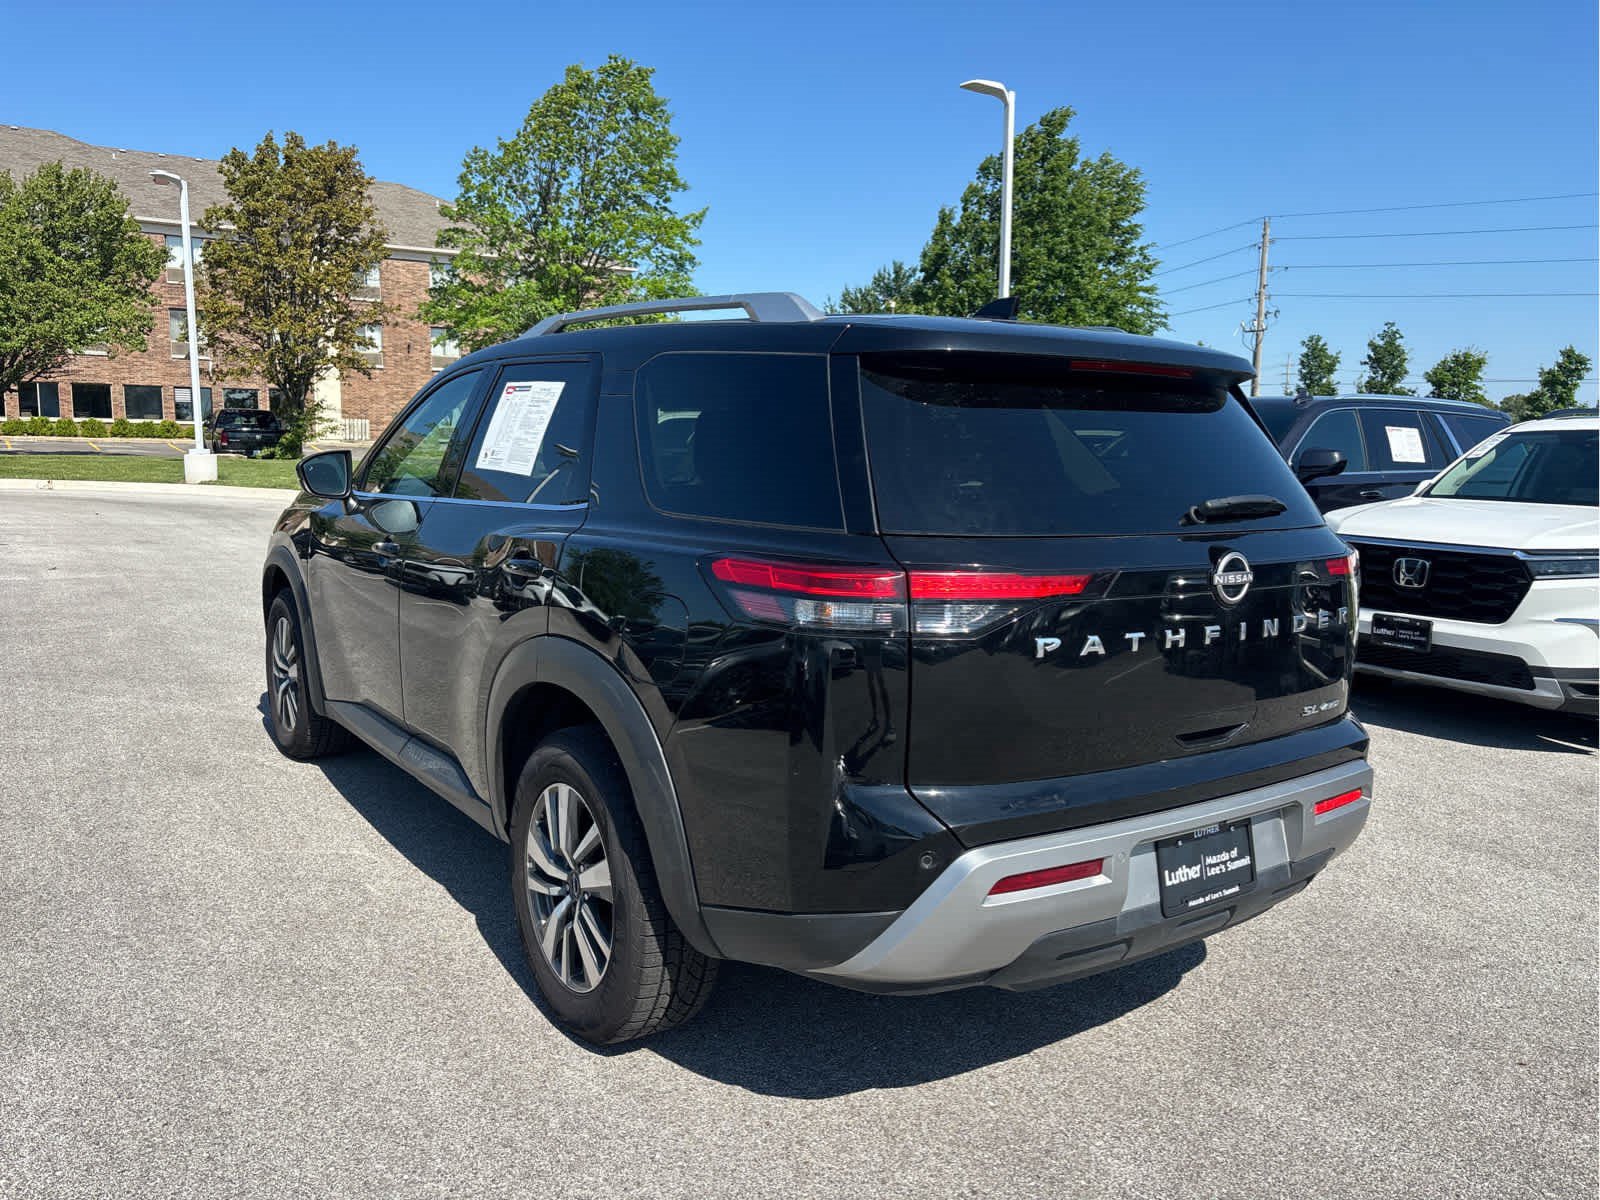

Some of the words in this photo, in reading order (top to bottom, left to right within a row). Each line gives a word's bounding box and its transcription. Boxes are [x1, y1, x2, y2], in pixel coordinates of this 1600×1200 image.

[1215, 574, 1253, 584] NISSAN
[1035, 606, 1348, 659] PATHFINDER
[1302, 704, 1319, 717] SL
[1193, 824, 1220, 838] LUTHER
[1205, 851, 1229, 865] Mazda
[1230, 847, 1238, 858] of
[1164, 864, 1201, 886] Luther
[1207, 864, 1226, 876] Lee's
[1227, 856, 1251, 871] Summit
